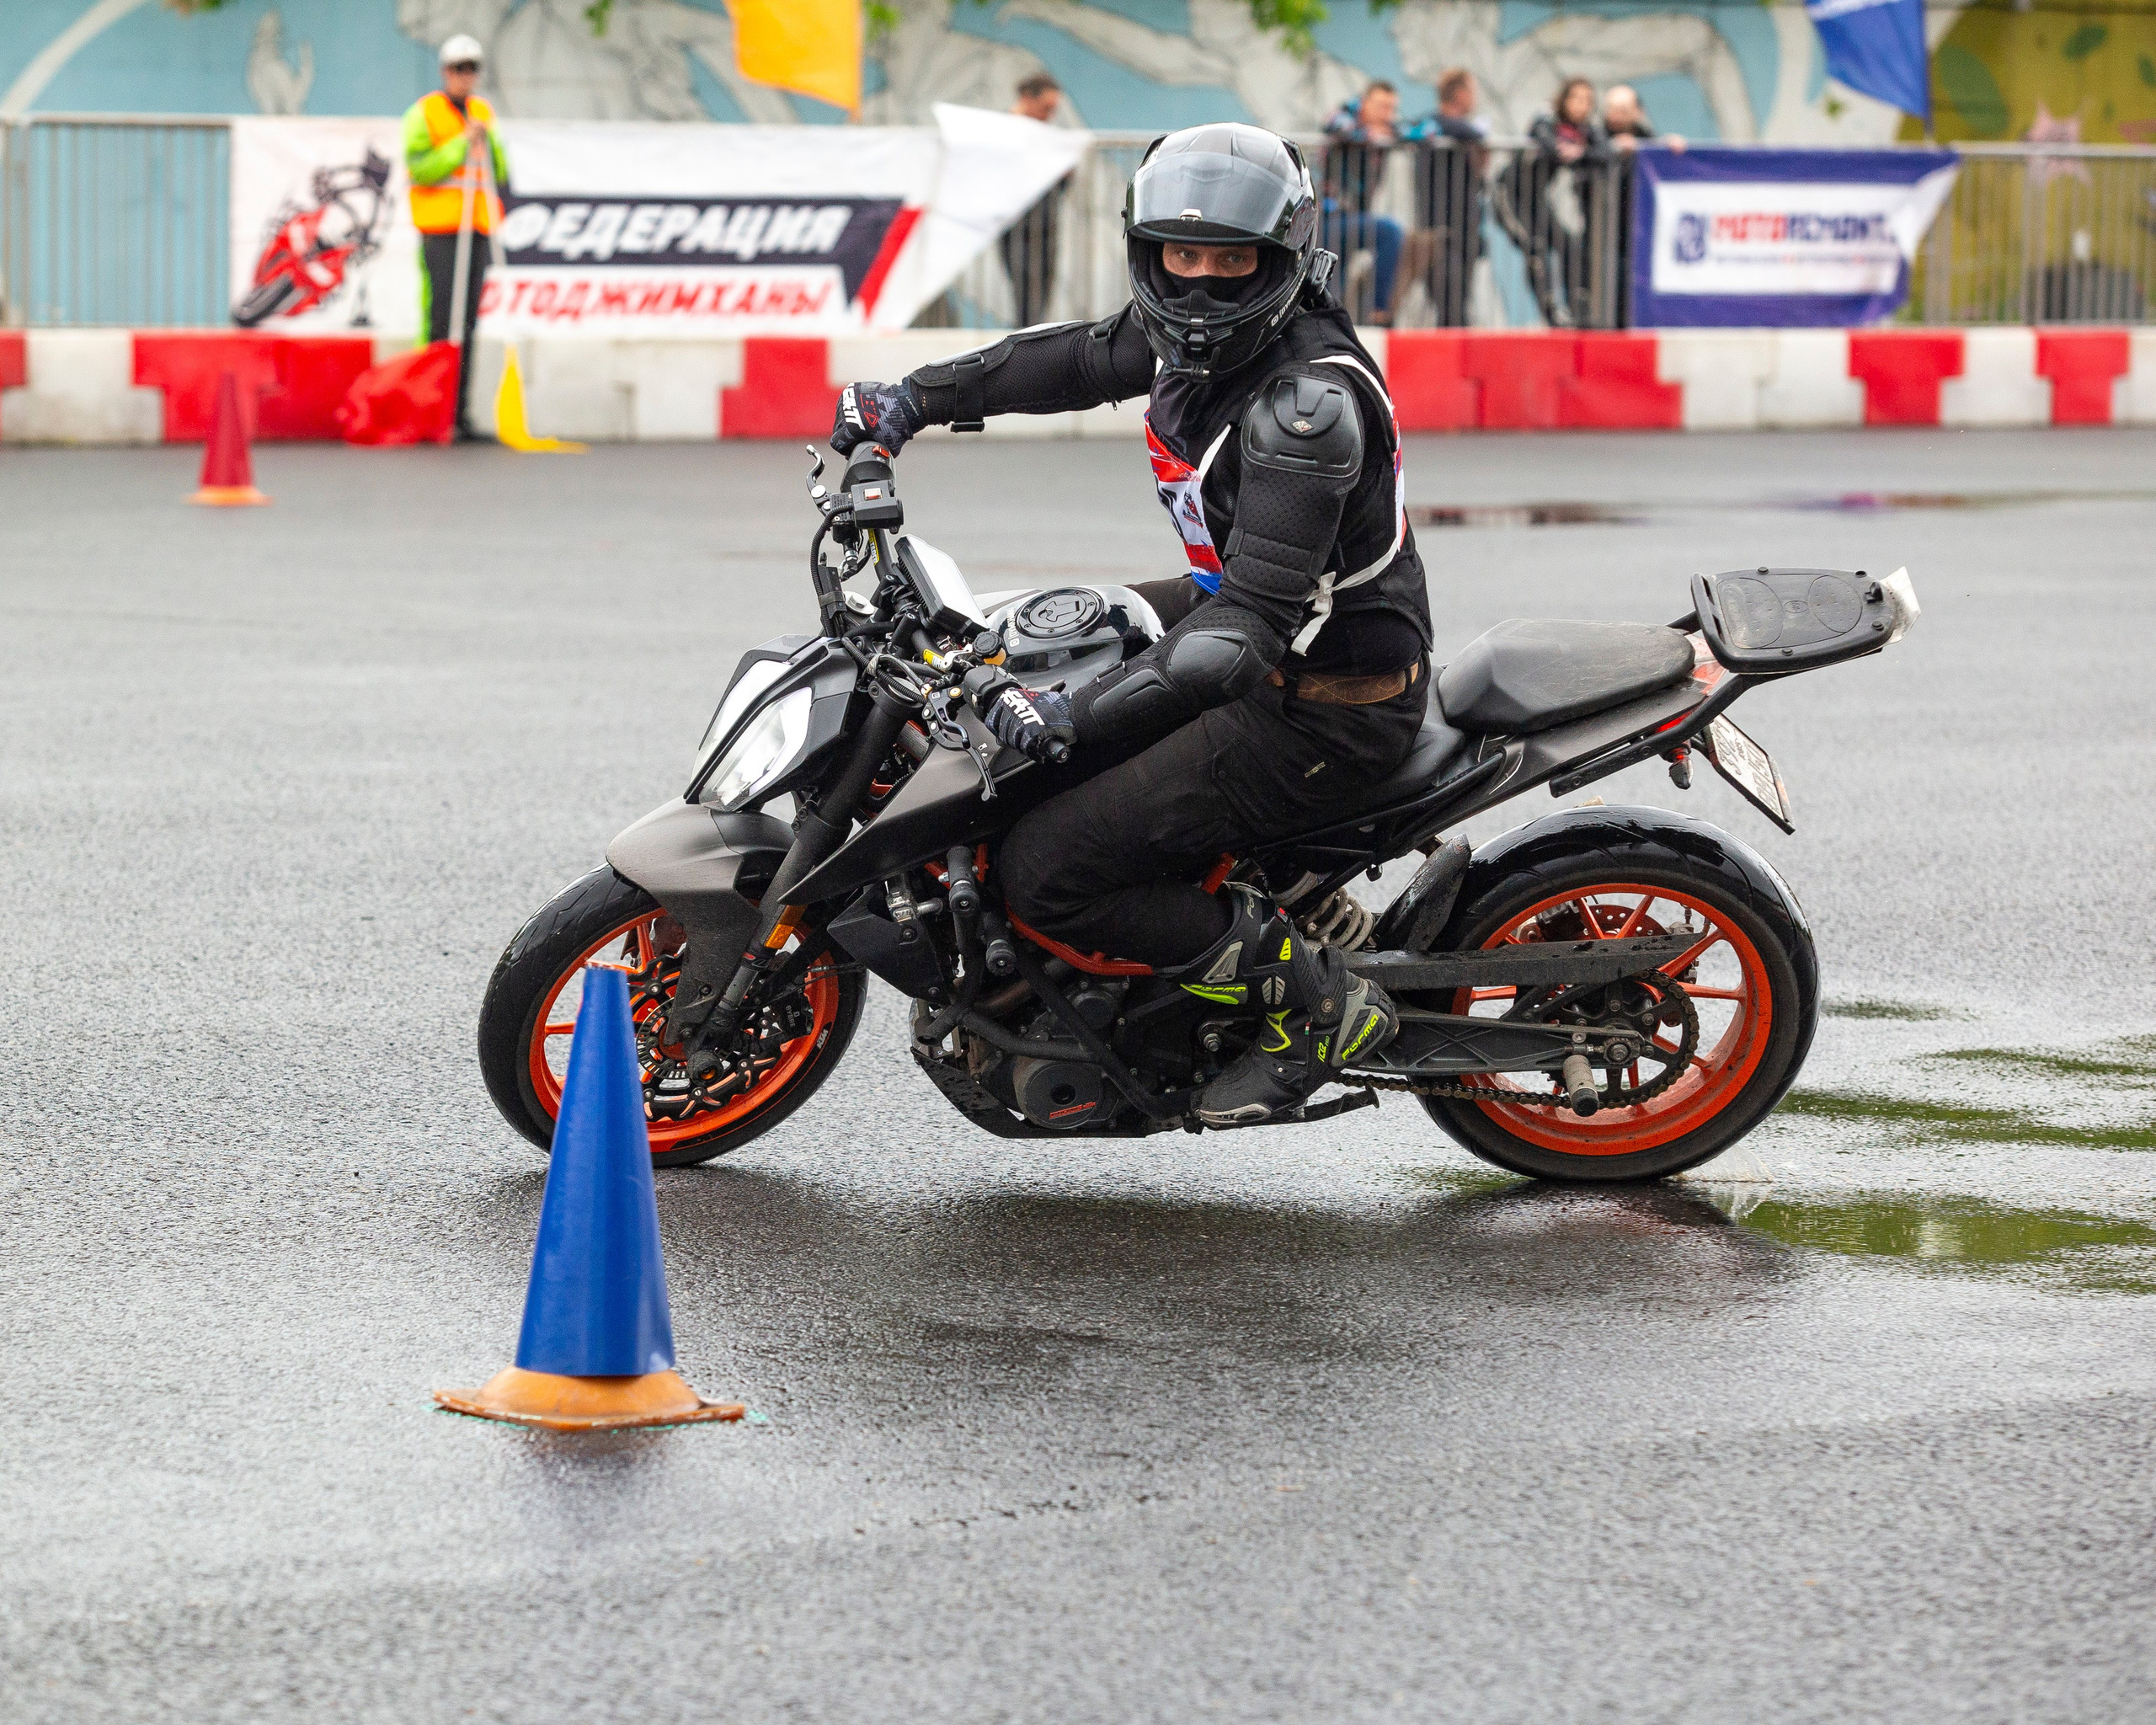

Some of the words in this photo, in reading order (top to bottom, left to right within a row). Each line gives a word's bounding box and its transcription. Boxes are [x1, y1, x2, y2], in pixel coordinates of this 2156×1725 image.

[504, 203, 851, 261] ФЕДЕРАЦИЯ
[477, 280, 831, 320] ОТОДЖИМХАНЫ
[816, 1029, 828, 1048] KTM
